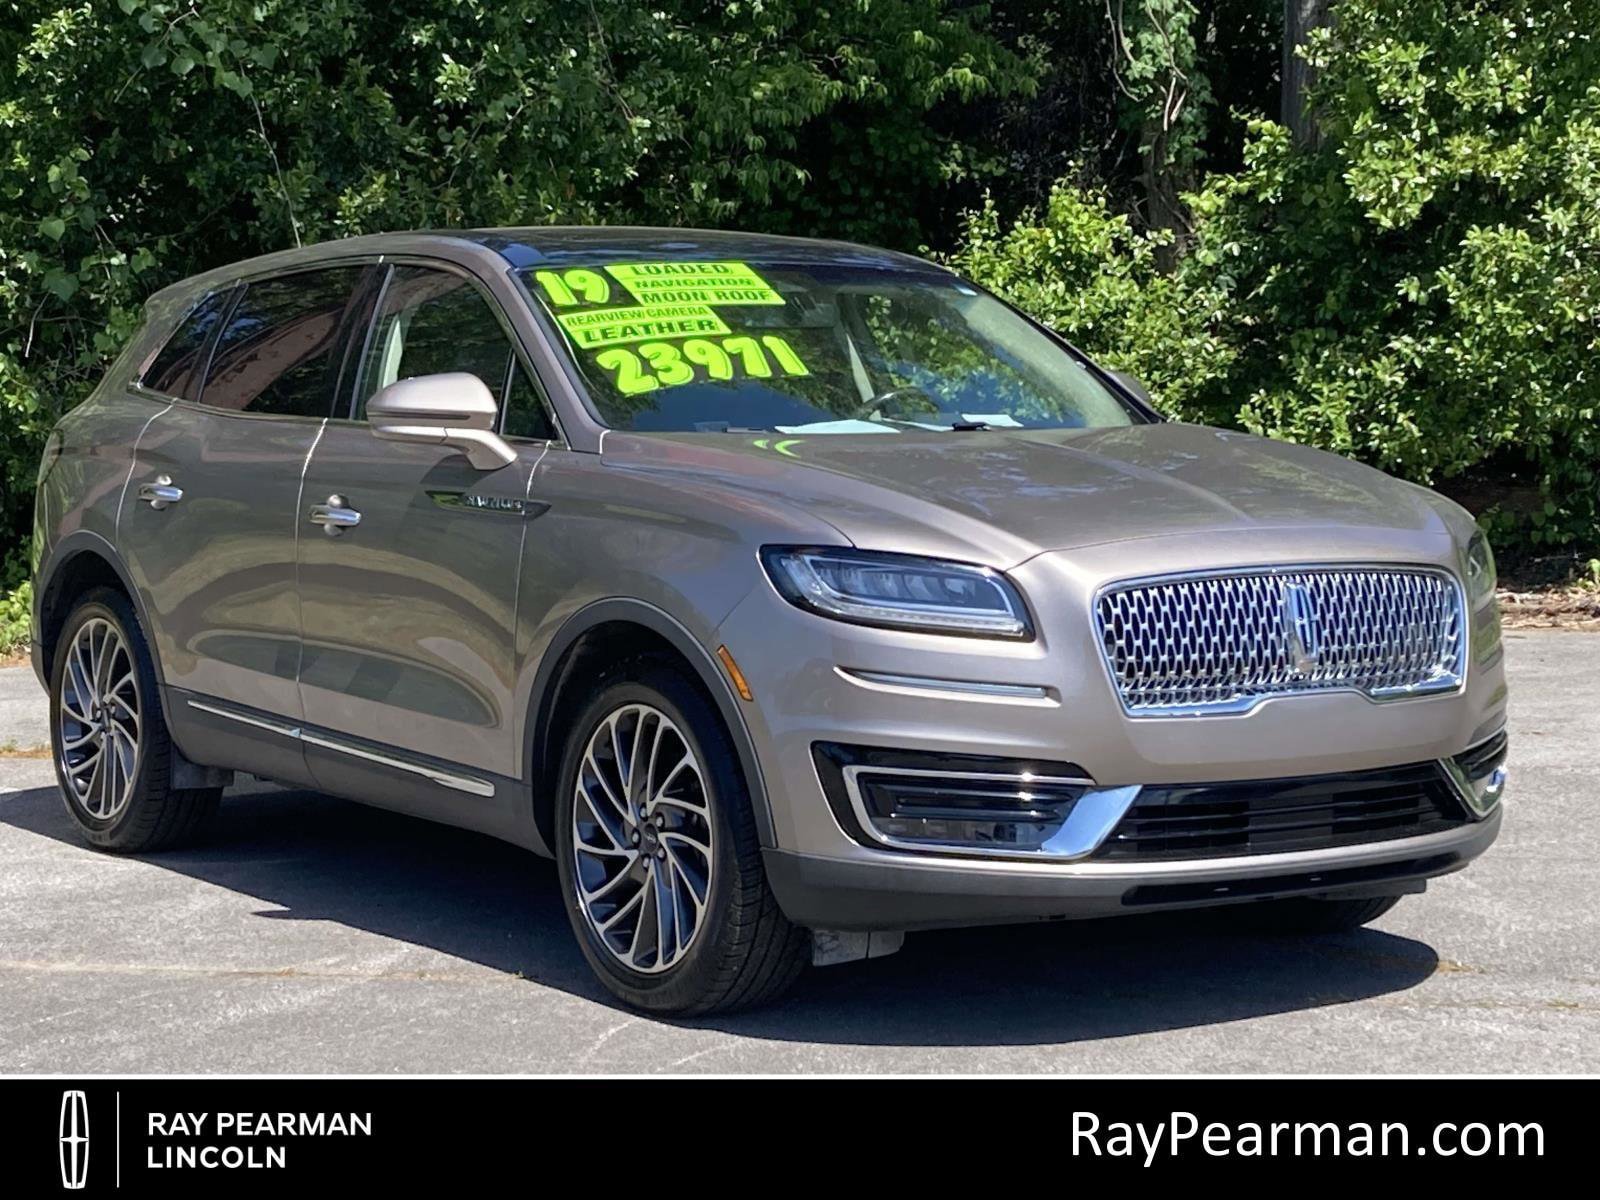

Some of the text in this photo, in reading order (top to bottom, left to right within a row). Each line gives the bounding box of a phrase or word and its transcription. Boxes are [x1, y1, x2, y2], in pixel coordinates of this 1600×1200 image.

[631, 263, 730, 276] LOADED
[535, 269, 611, 306] 19
[635, 277, 752, 289] NAVIGATION
[643, 289, 771, 305] MOON ROOF
[565, 305, 708, 326] REARVIEW CAMERA
[583, 319, 717, 343] LEATHER
[595, 335, 810, 395] 23971
